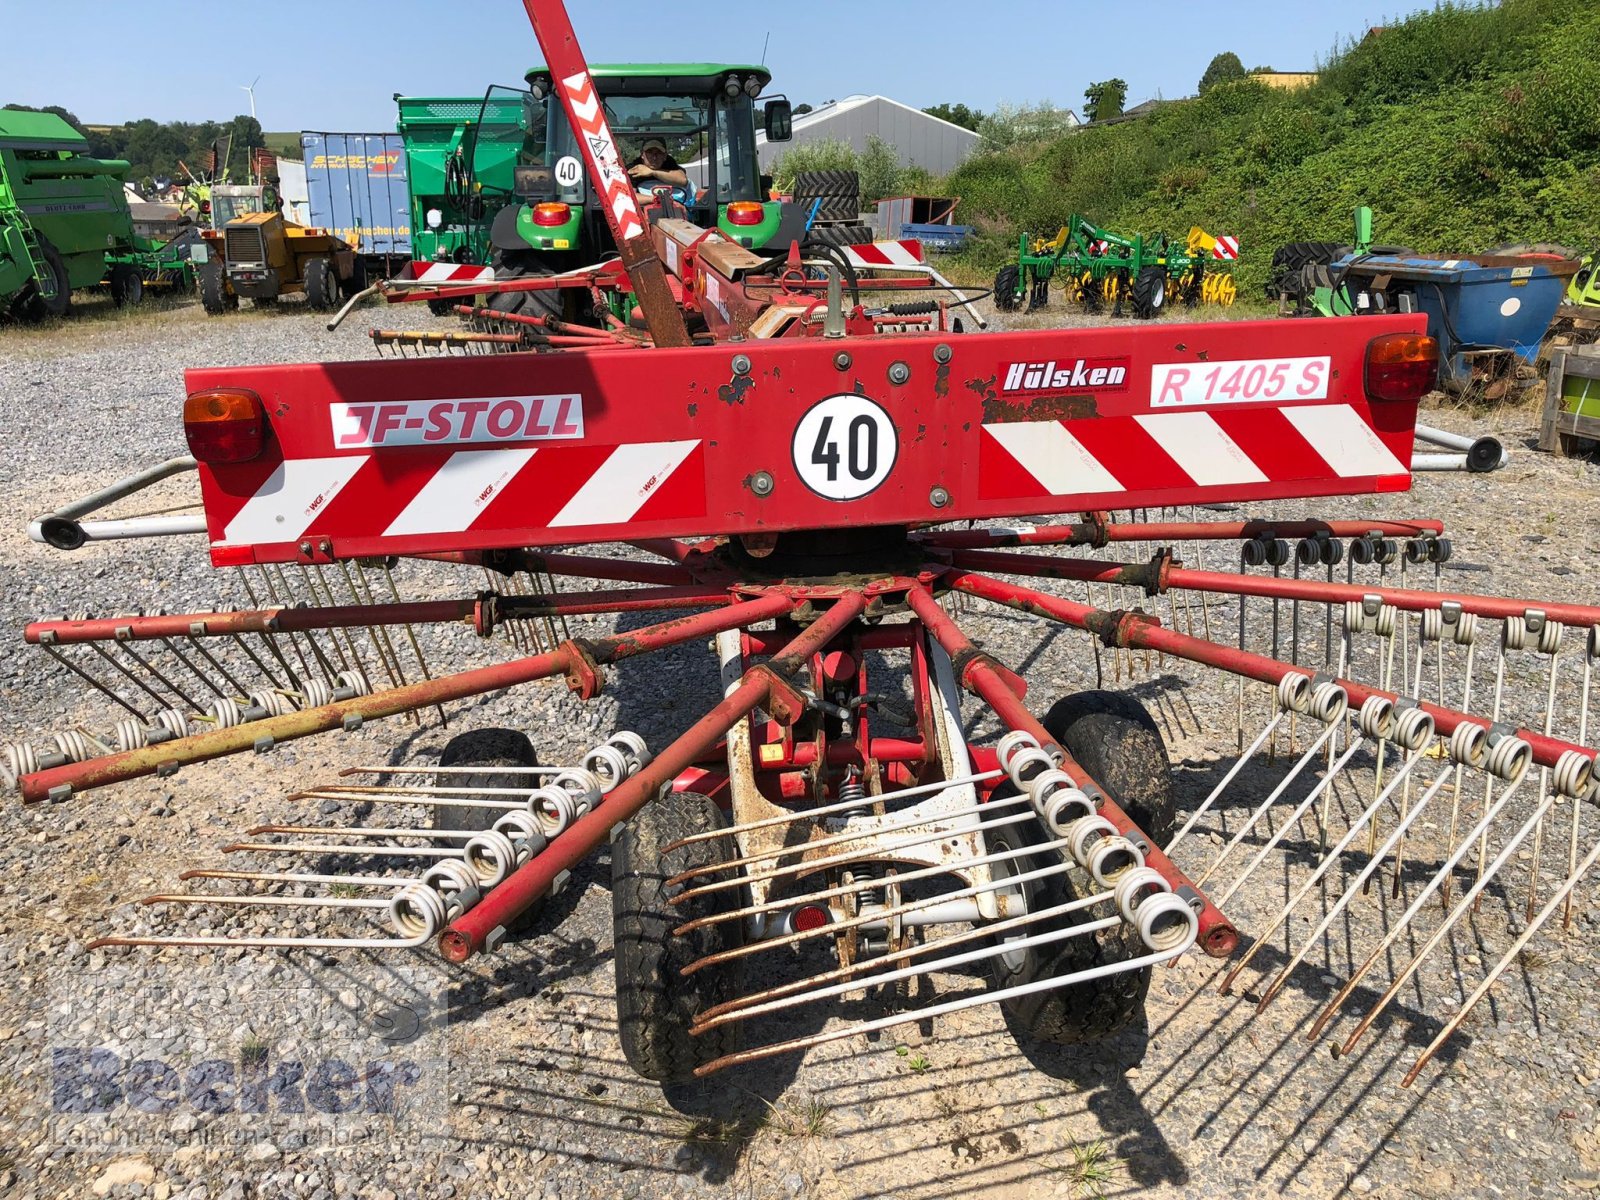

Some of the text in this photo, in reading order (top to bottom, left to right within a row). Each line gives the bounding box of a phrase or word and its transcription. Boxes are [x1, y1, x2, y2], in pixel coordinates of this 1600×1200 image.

[560, 162, 576, 180] 40
[1002, 359, 1127, 391] Hülsken
[1158, 360, 1325, 403] R 1405 S
[339, 397, 578, 445] JF-STOLL
[811, 414, 878, 481] 40
[479, 484, 494, 501] WGF
[643, 475, 658, 491] WGF
[309, 493, 325, 511] WGF
